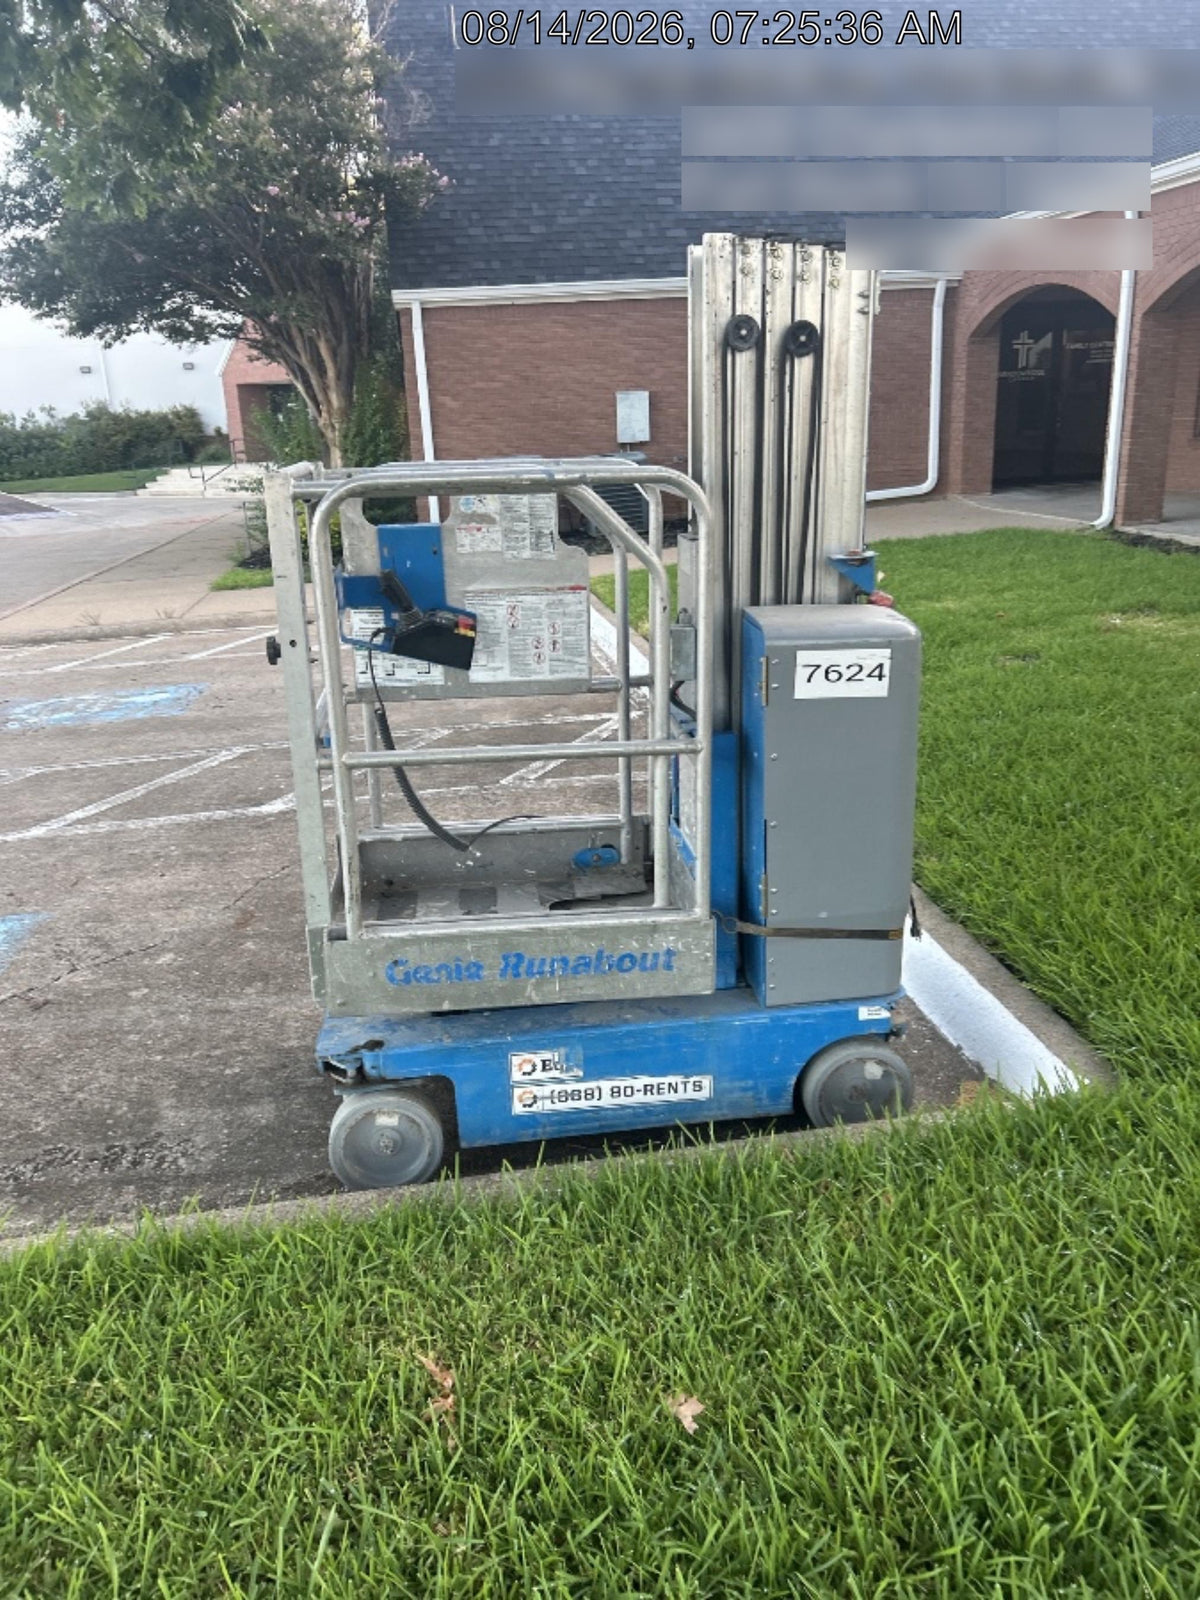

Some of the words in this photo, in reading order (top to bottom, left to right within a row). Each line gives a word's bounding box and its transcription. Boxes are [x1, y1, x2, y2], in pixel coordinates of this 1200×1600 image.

[802, 662, 887, 683] 7624
[385, 957, 485, 987] Genie
[500, 947, 678, 980] Runabout
[610, 1080, 703, 1098] 80-RENTS
